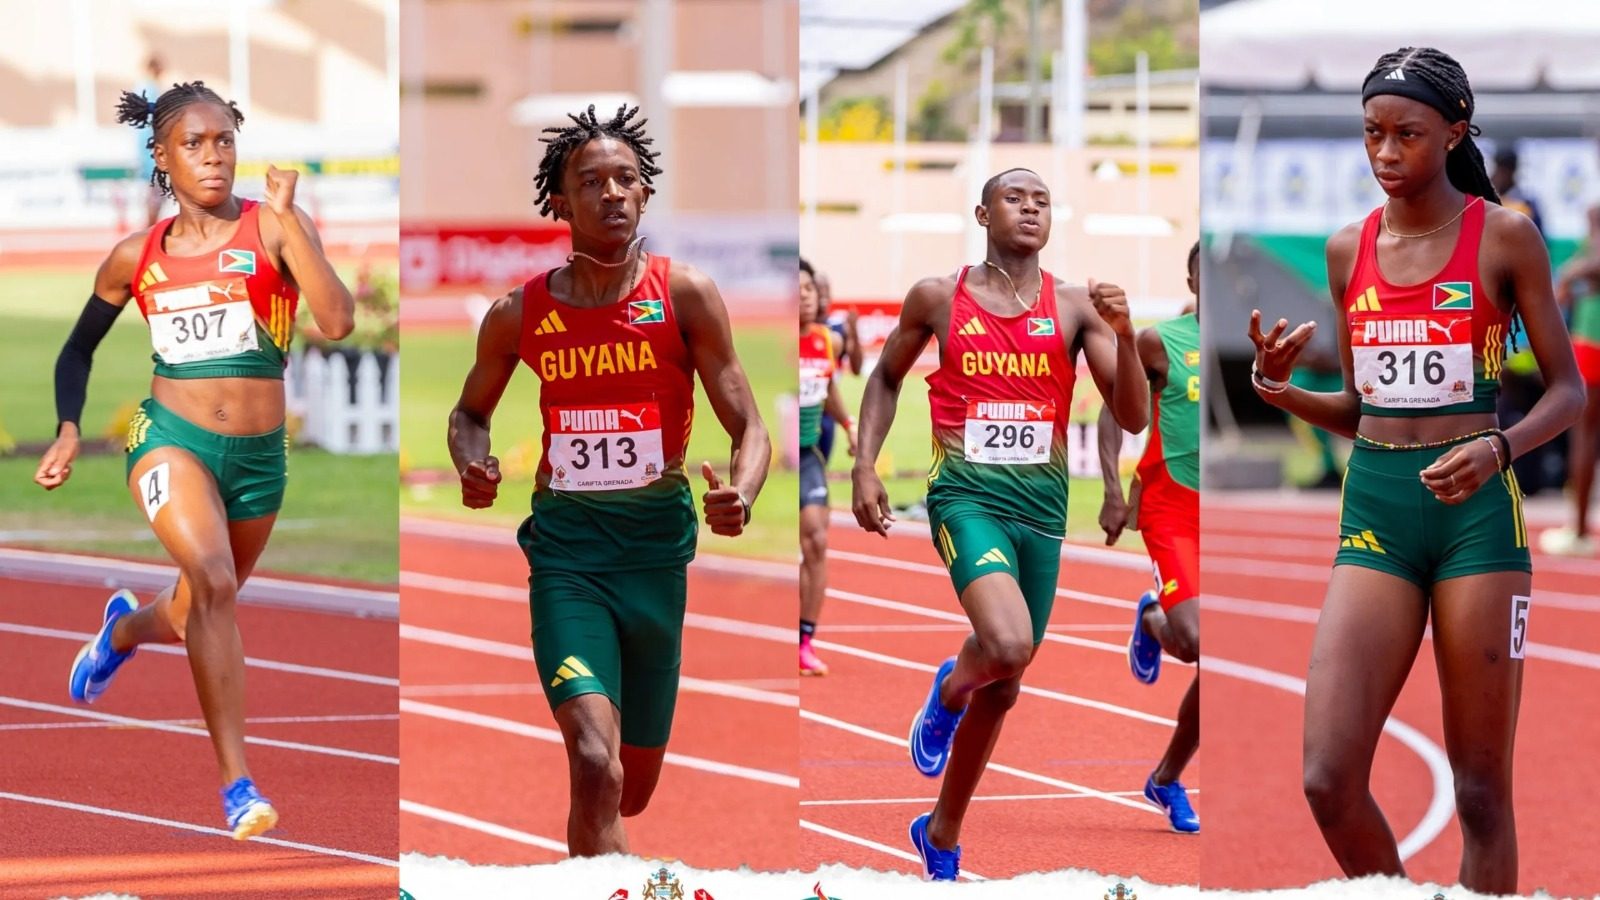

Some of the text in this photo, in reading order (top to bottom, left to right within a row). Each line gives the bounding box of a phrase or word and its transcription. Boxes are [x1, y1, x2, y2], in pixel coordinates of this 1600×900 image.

[172, 308, 227, 344] 307
[1363, 319, 1428, 344] PUMA
[540, 340, 658, 382] GUYANA
[961, 351, 1051, 377] GUYANA
[1377, 350, 1446, 385] 316
[559, 409, 619, 431] PUMA
[976, 401, 1026, 420] PUMA
[984, 424, 1035, 449] 296
[570, 437, 638, 470] 313
[148, 470, 162, 506] 4
[603, 479, 634, 487] GRENADA
[1513, 600, 1528, 654] 5
